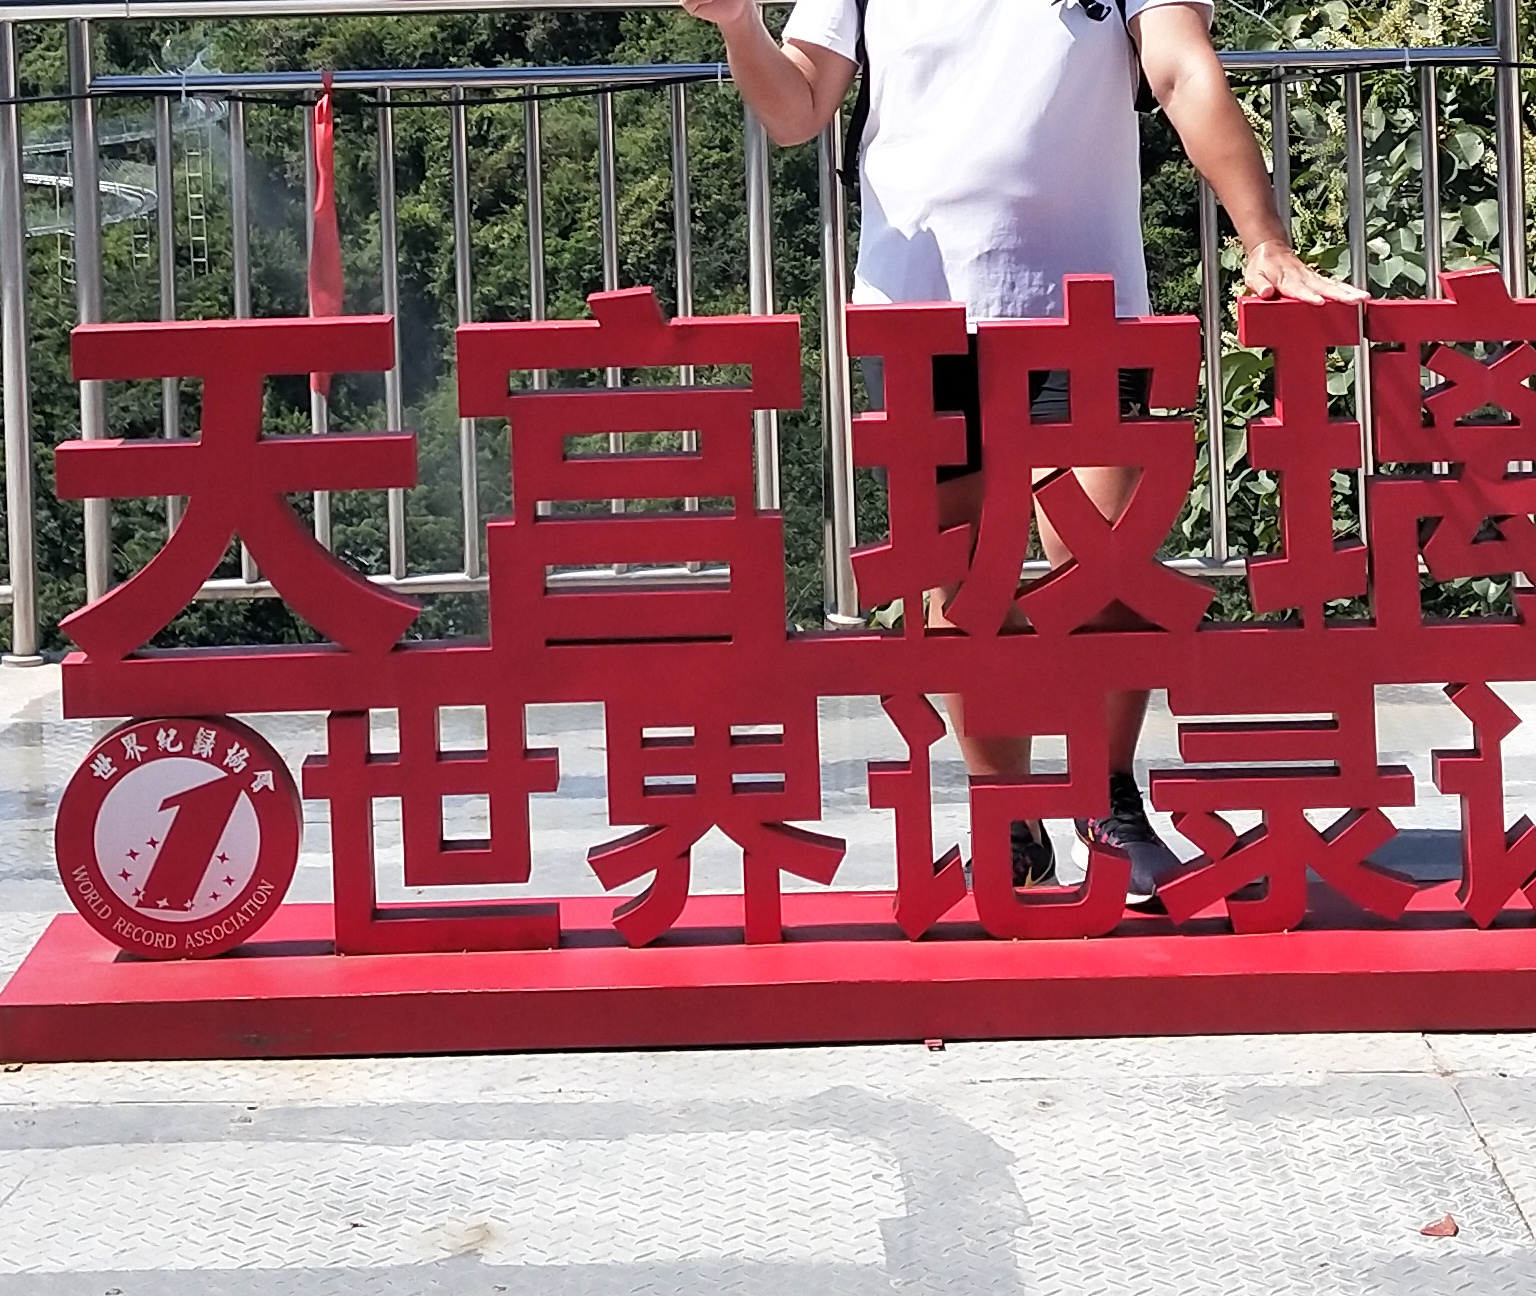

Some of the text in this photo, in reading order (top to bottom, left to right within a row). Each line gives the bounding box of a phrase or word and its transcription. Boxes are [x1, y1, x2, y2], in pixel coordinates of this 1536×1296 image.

[71, 864, 275, 950] WORLD RECORD ASSOCIATION
